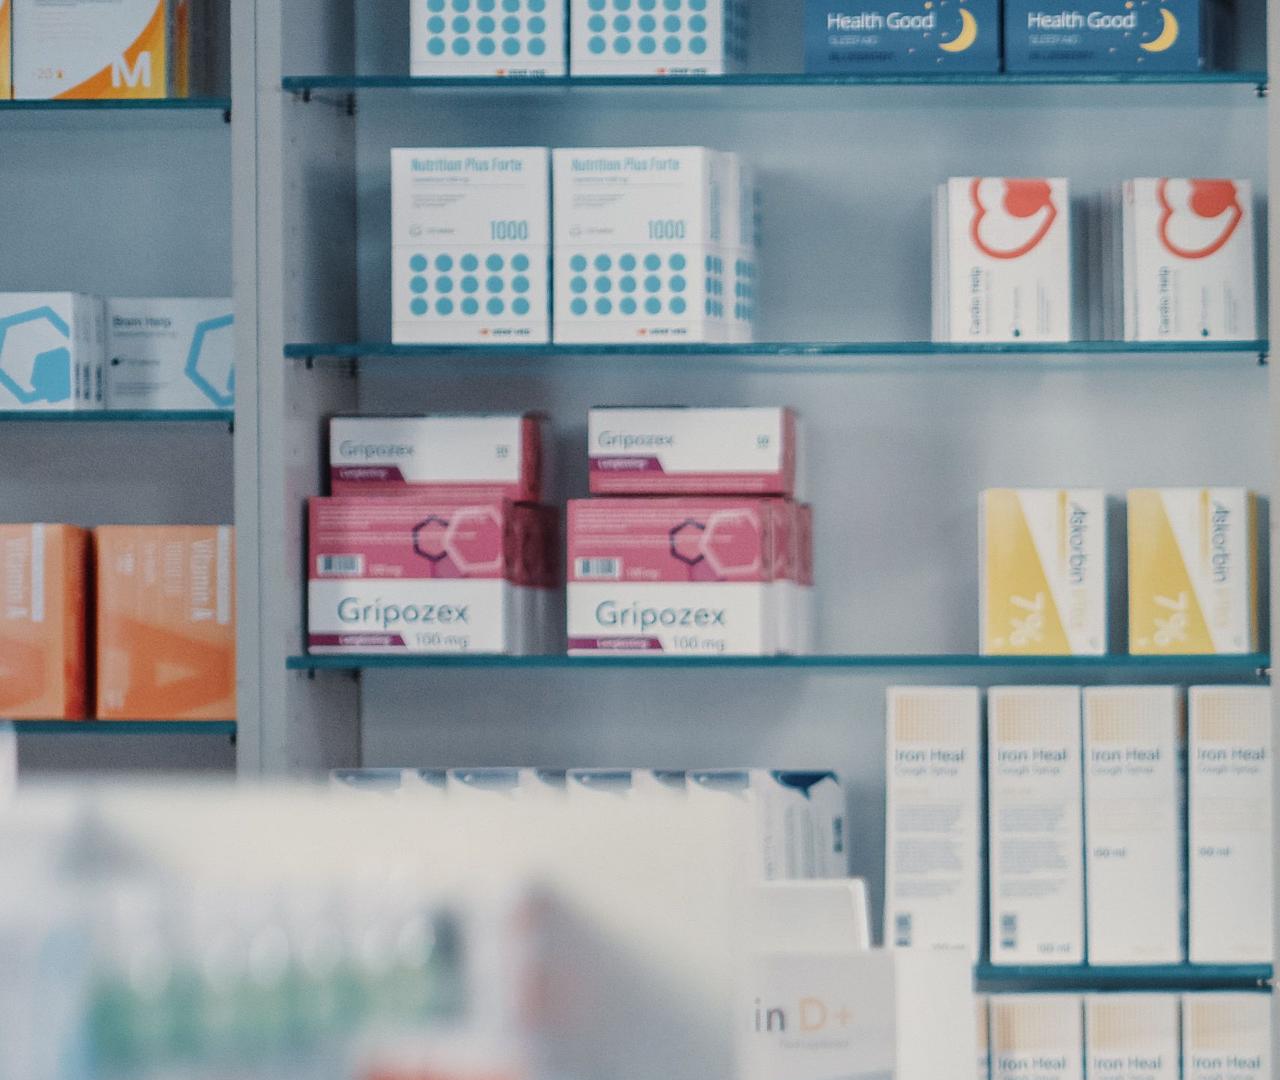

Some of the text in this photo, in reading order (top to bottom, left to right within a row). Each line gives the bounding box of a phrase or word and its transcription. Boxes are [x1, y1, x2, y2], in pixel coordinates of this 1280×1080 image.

[827, 11, 935, 31] Health Good
[1027, 11, 1136, 31] Health Good
[111, 51, 153, 88] M
[490, 219, 529, 241] 1000
[647, 219, 687, 241] 1000
[597, 431, 674, 450] Gripozex
[337, 597, 470, 628] Gripozex
[595, 600, 726, 634] Gripozex
[671, 636, 698, 651] 100
[895, 749, 966, 762] Iron Heal
[996, 749, 1068, 762] Iron Heal
[1091, 749, 1161, 762] Iron Heal
[1197, 748, 1266, 761] Iron Heal
[998, 1056, 1067, 1070] Iron Heal
[1092, 1056, 1163, 1070] Iron Heal
[1191, 1055, 1262, 1069] Iron Heal
